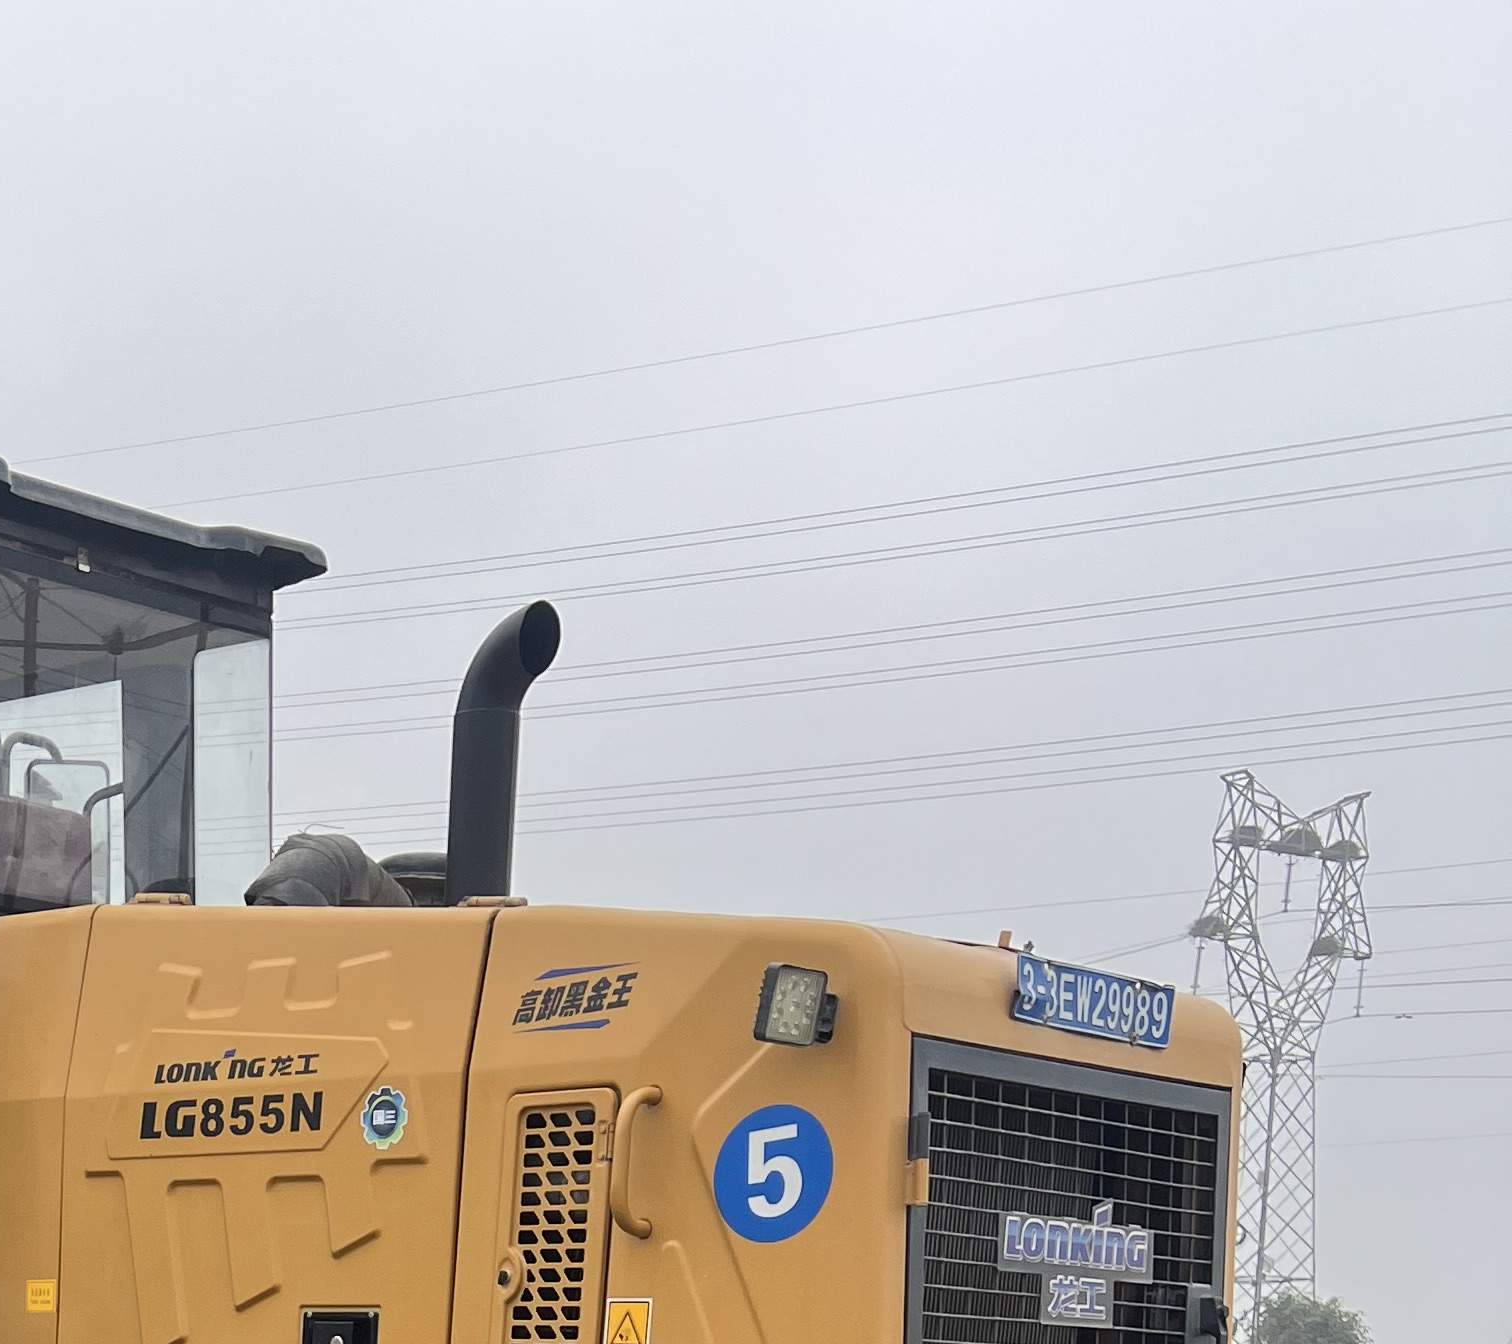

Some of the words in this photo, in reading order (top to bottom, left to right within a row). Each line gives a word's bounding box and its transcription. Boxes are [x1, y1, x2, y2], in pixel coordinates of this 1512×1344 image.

[512, 972, 638, 1025] 高卸黑金王
[268, 1053, 320, 1077] 龙工
[140, 1091, 324, 1140] LG855N
[747, 1123, 803, 1218] 5
[1004, 1203, 1149, 1273] LONKING
[1048, 1274, 1107, 1320] 龙工
